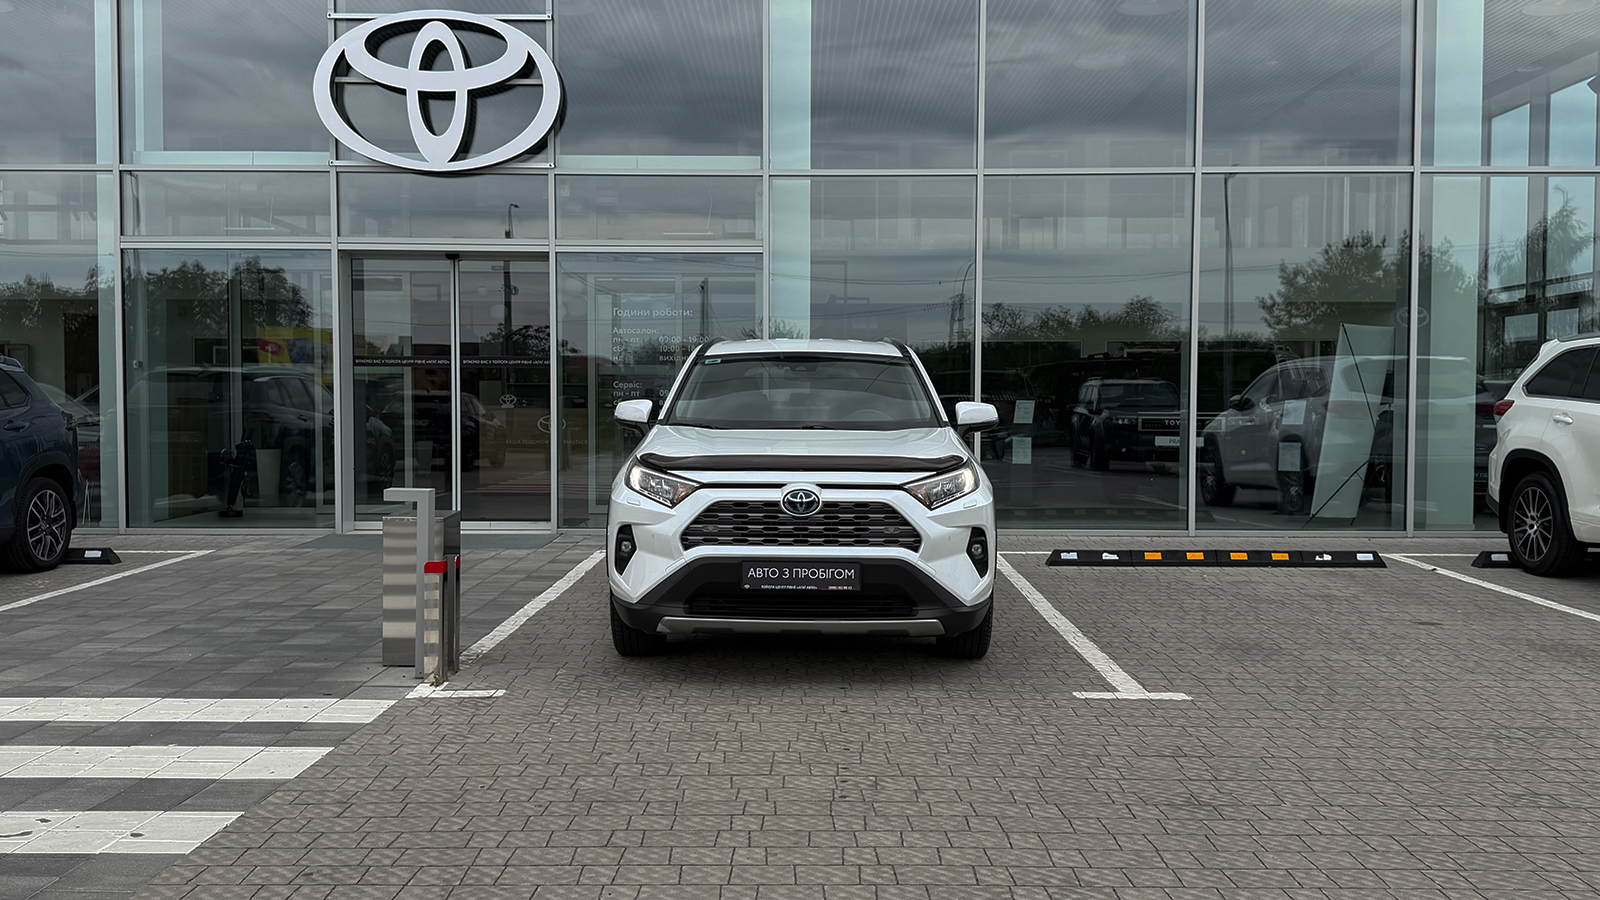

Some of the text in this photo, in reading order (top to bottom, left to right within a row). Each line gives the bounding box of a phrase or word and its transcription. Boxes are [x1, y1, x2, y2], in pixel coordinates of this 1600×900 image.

[613, 308, 693, 318] Години роботи:
[613, 380, 642, 389] Сервіс:
[748, 568, 855, 579] АВТО З ПРОБІГОМ
